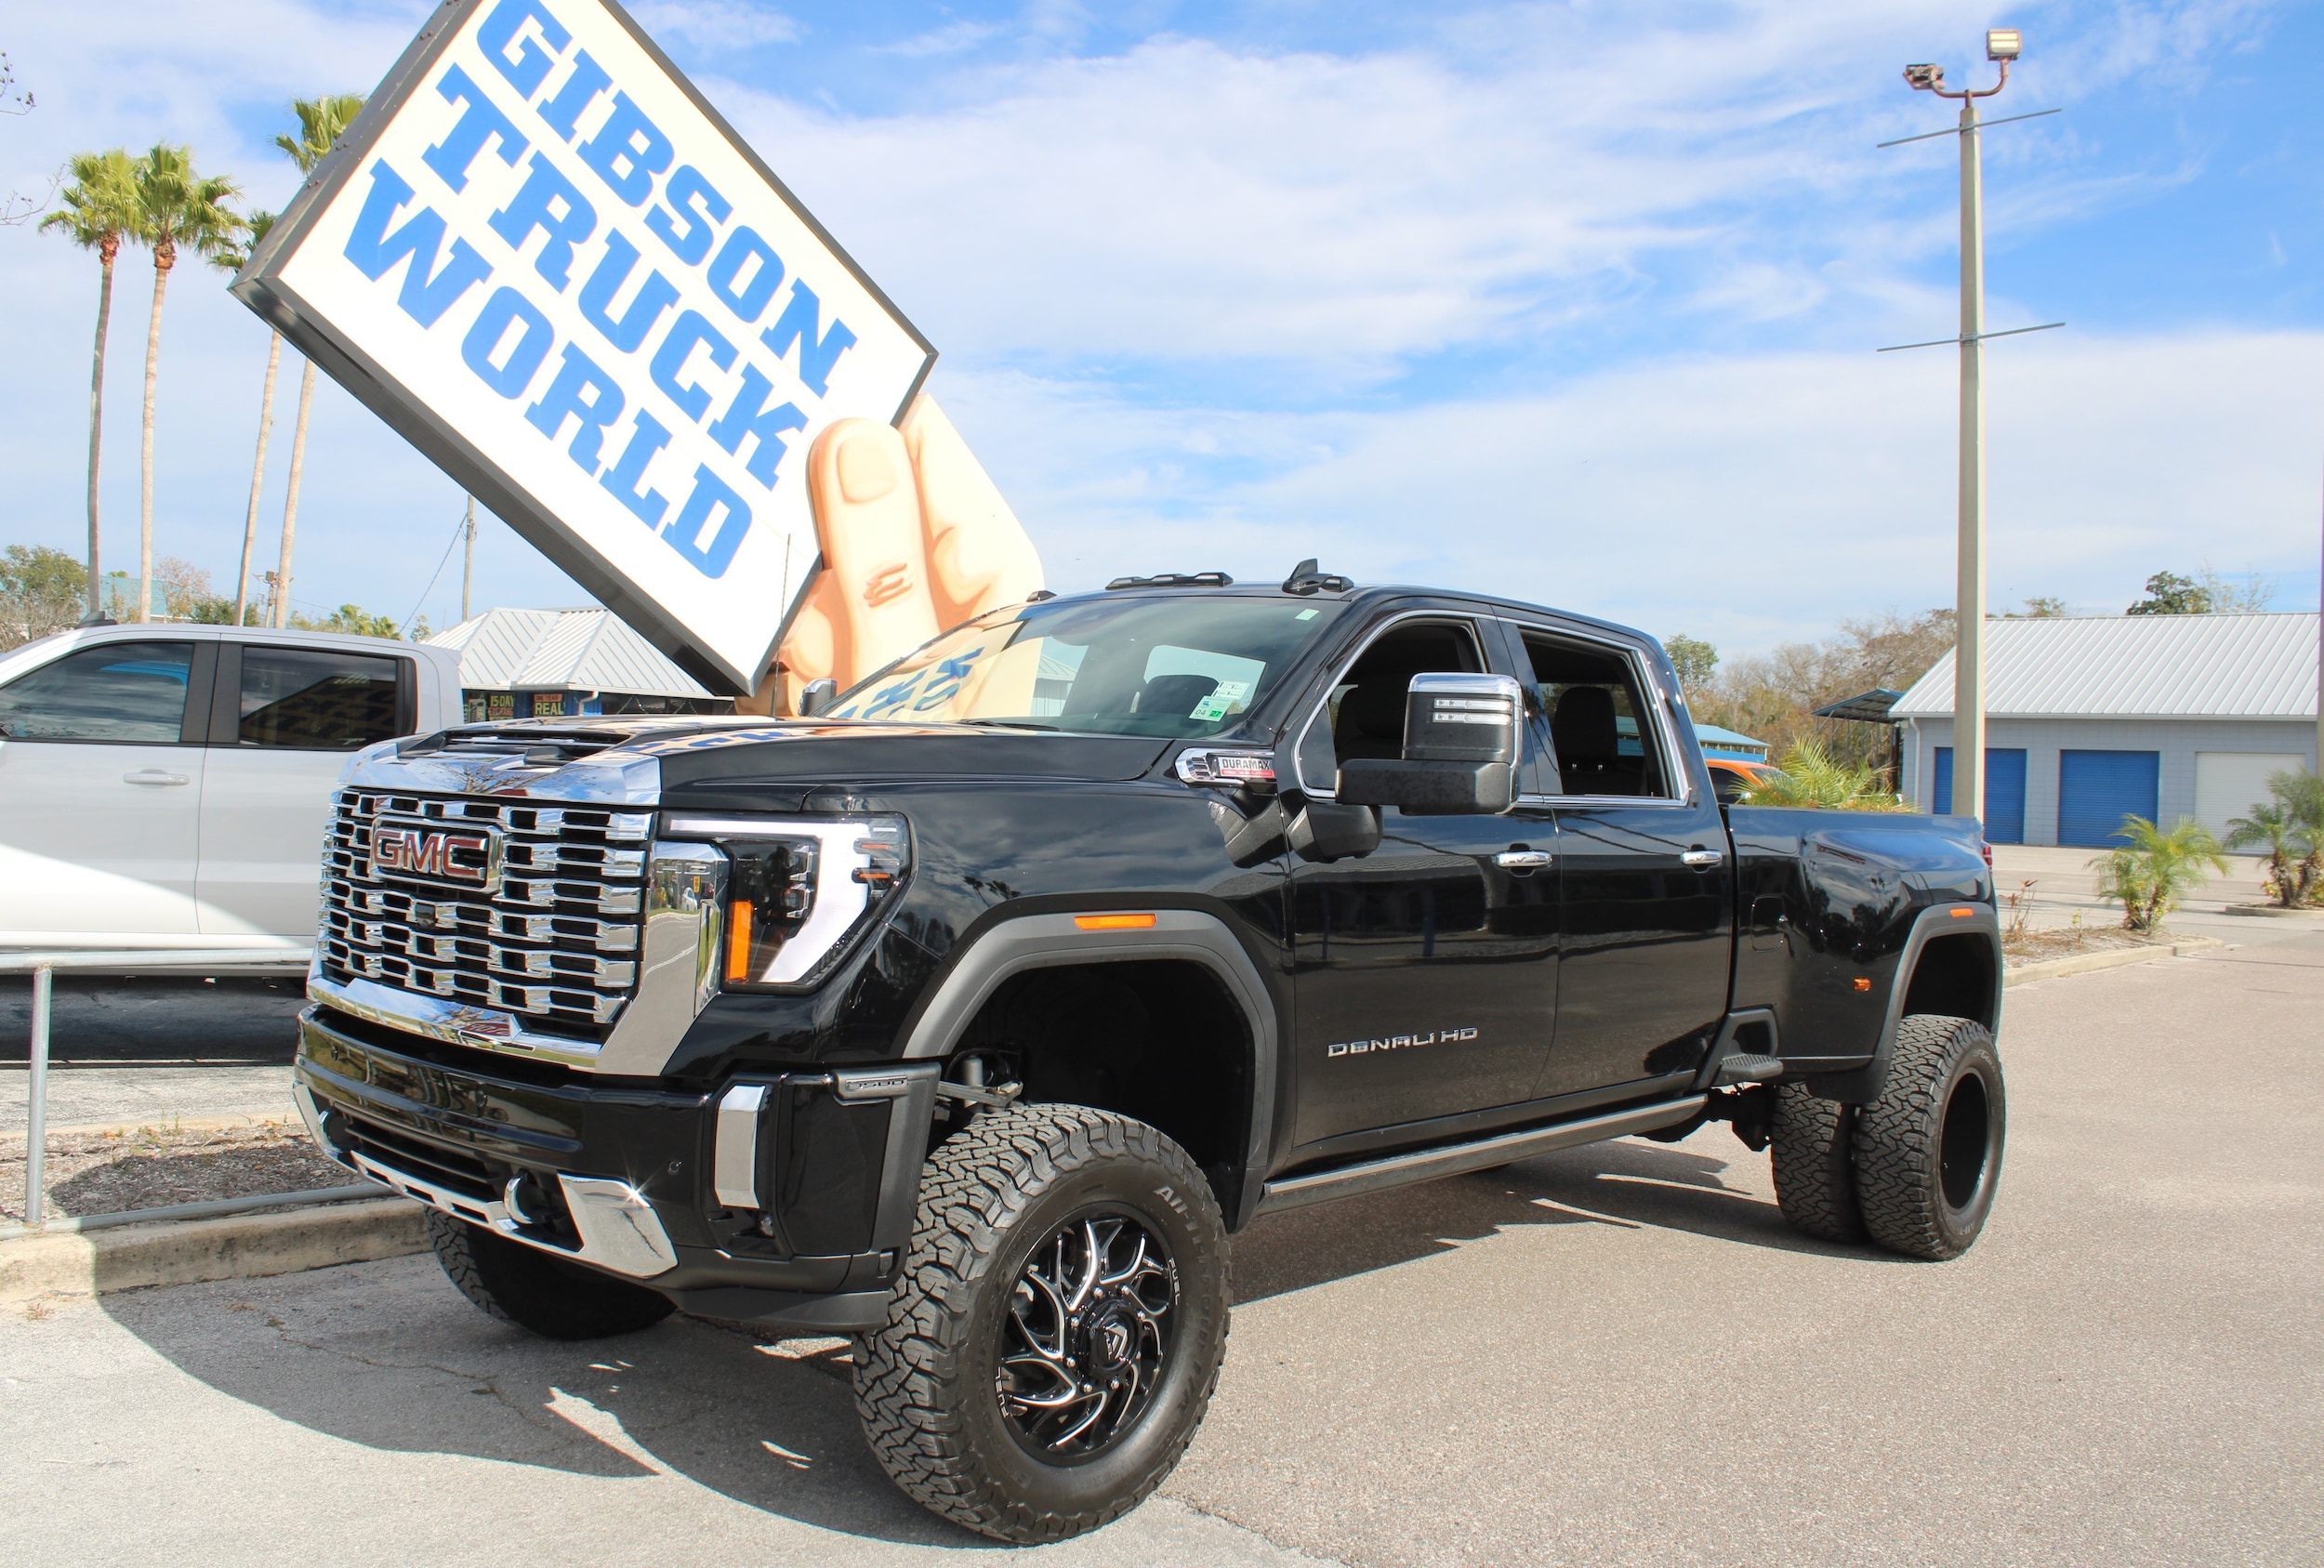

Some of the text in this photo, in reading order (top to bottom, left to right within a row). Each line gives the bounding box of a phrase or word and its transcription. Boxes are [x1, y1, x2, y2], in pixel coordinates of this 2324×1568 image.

[477, 0, 855, 397] GIBSON
[423, 62, 807, 489] TRUCK
[343, 159, 751, 578] WORLD
[490, 695, 514, 707] 15 DAY
[535, 702, 564, 715] REAL
[1221, 758, 1271, 771] DURAMAX
[372, 826, 487, 878] GMC
[1327, 1027, 1478, 1058] DENALI HD
[1168, 1257, 1181, 1306] FUEL
[995, 1365, 1010, 1418] FUEL
